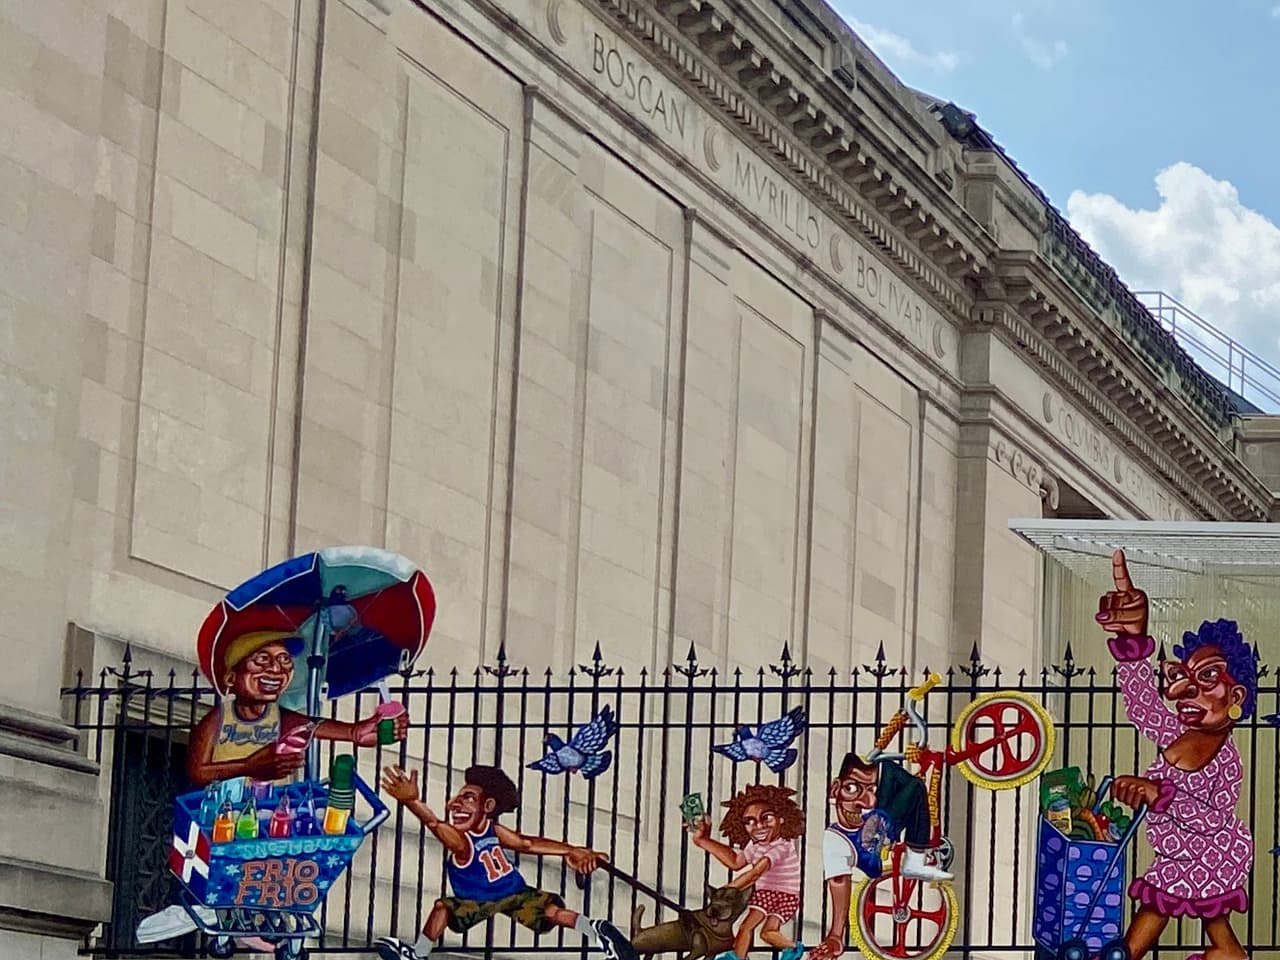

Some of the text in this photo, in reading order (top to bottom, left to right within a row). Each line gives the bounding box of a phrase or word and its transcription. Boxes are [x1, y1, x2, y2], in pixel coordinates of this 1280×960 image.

[593, 32, 687, 138] BOSCAN
[735, 152, 820, 248] MVRILLO
[857, 256, 923, 340] BOLIVAR
[234, 881, 319, 907] FRIO
[242, 859, 320, 883] FRIO
[479, 845, 514, 883] 11
